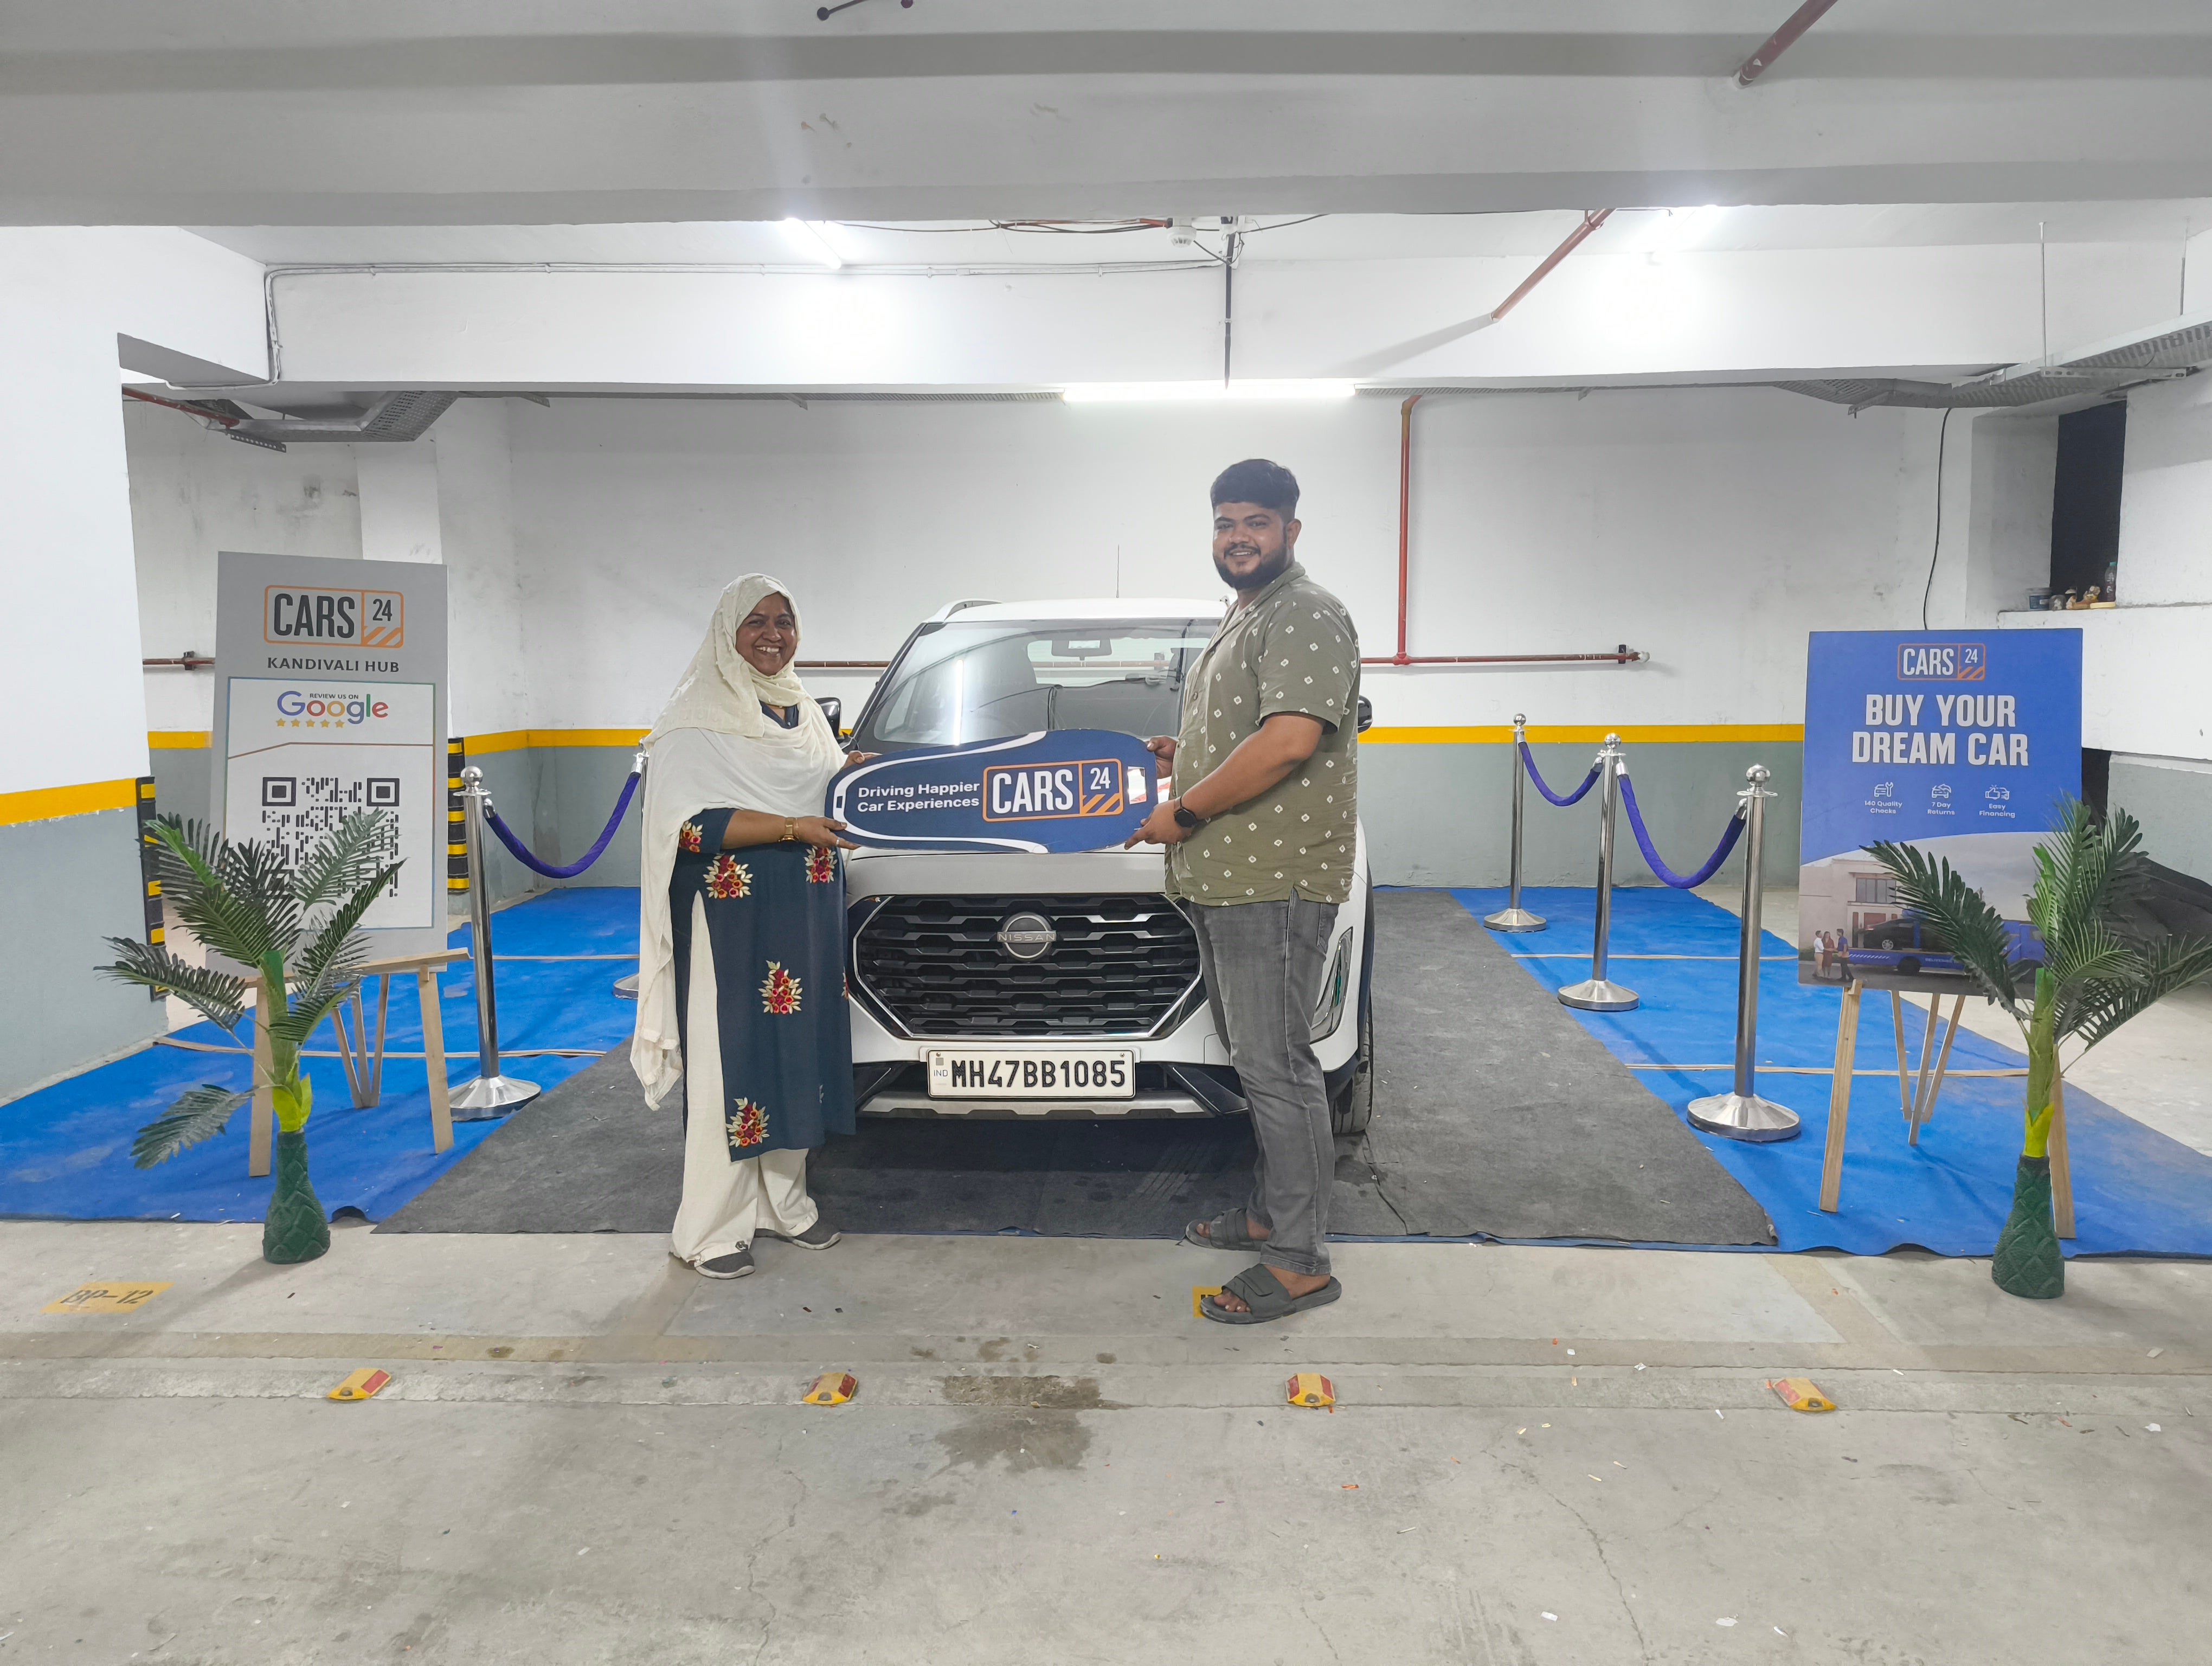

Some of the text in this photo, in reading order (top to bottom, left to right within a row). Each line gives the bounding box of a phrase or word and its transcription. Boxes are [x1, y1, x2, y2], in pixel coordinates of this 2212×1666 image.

[273, 593, 393, 638] CARS 24
[267, 657, 399, 672] KANDIVALI HUB
[1903, 648, 1978, 676] CARS 24
[277, 690, 389, 724] Google
[1866, 694, 2016, 727] BUY YOUR
[1852, 731, 2029, 766] DREAM CAR
[857, 796, 980, 812] Car Experiences
[858, 781, 980, 799] Driving Happier
[992, 767, 1111, 814] CARS 24
[998, 933, 1056, 941] NISSAN
[951, 1060, 1126, 1087] MH47BB1085
